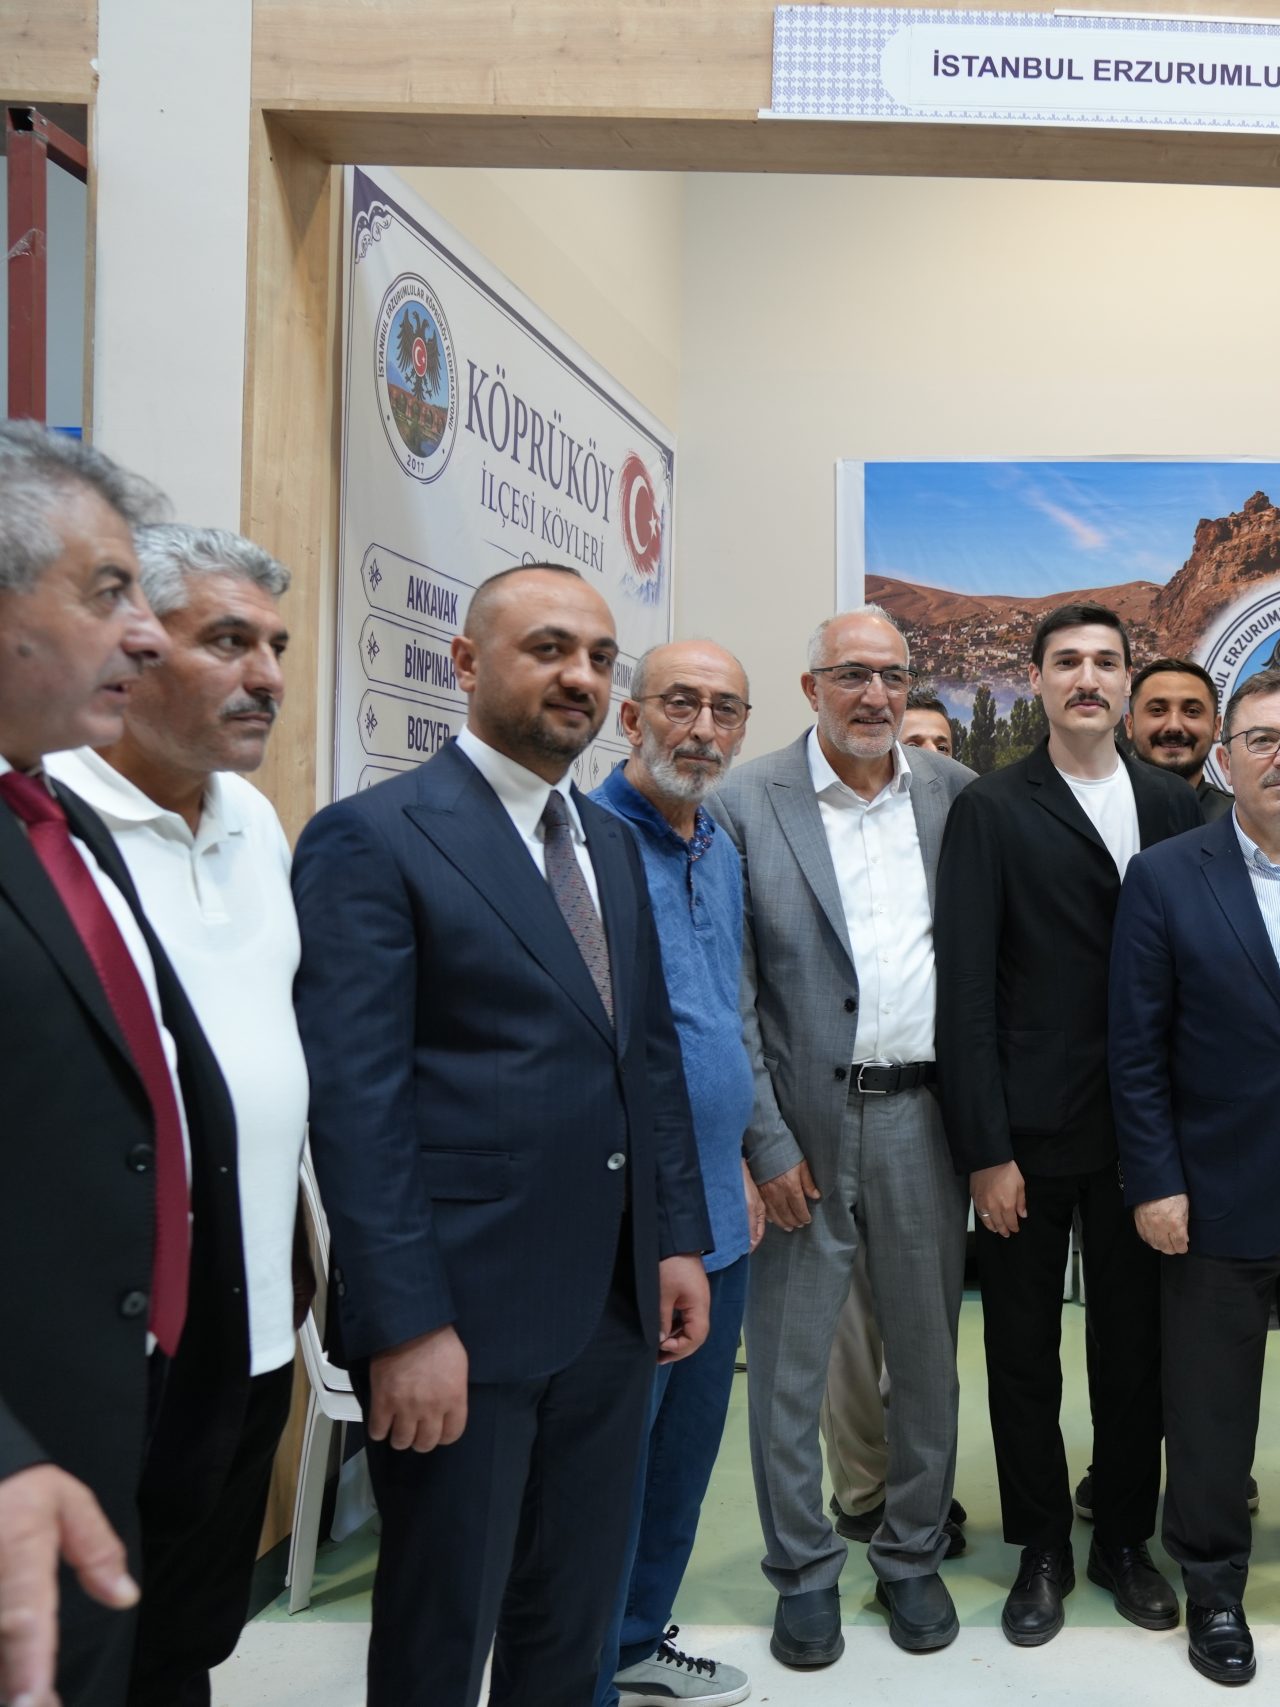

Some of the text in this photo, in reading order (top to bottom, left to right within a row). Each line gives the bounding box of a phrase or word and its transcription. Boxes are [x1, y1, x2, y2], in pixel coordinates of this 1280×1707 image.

[933, 50, 1083, 80] İSTANBUL
[378, 317, 389, 378] İSTANBUL
[446, 344, 456, 432] FEDERASYONU
[406, 454, 425, 474] 2017
[465, 359, 614, 523] KÖPRÜKÖY
[480, 460, 605, 573] İLÇESİ KÖYLERİ
[406, 575, 458, 626] AKKAVAK
[404, 639, 457, 691] BİNPINAR
